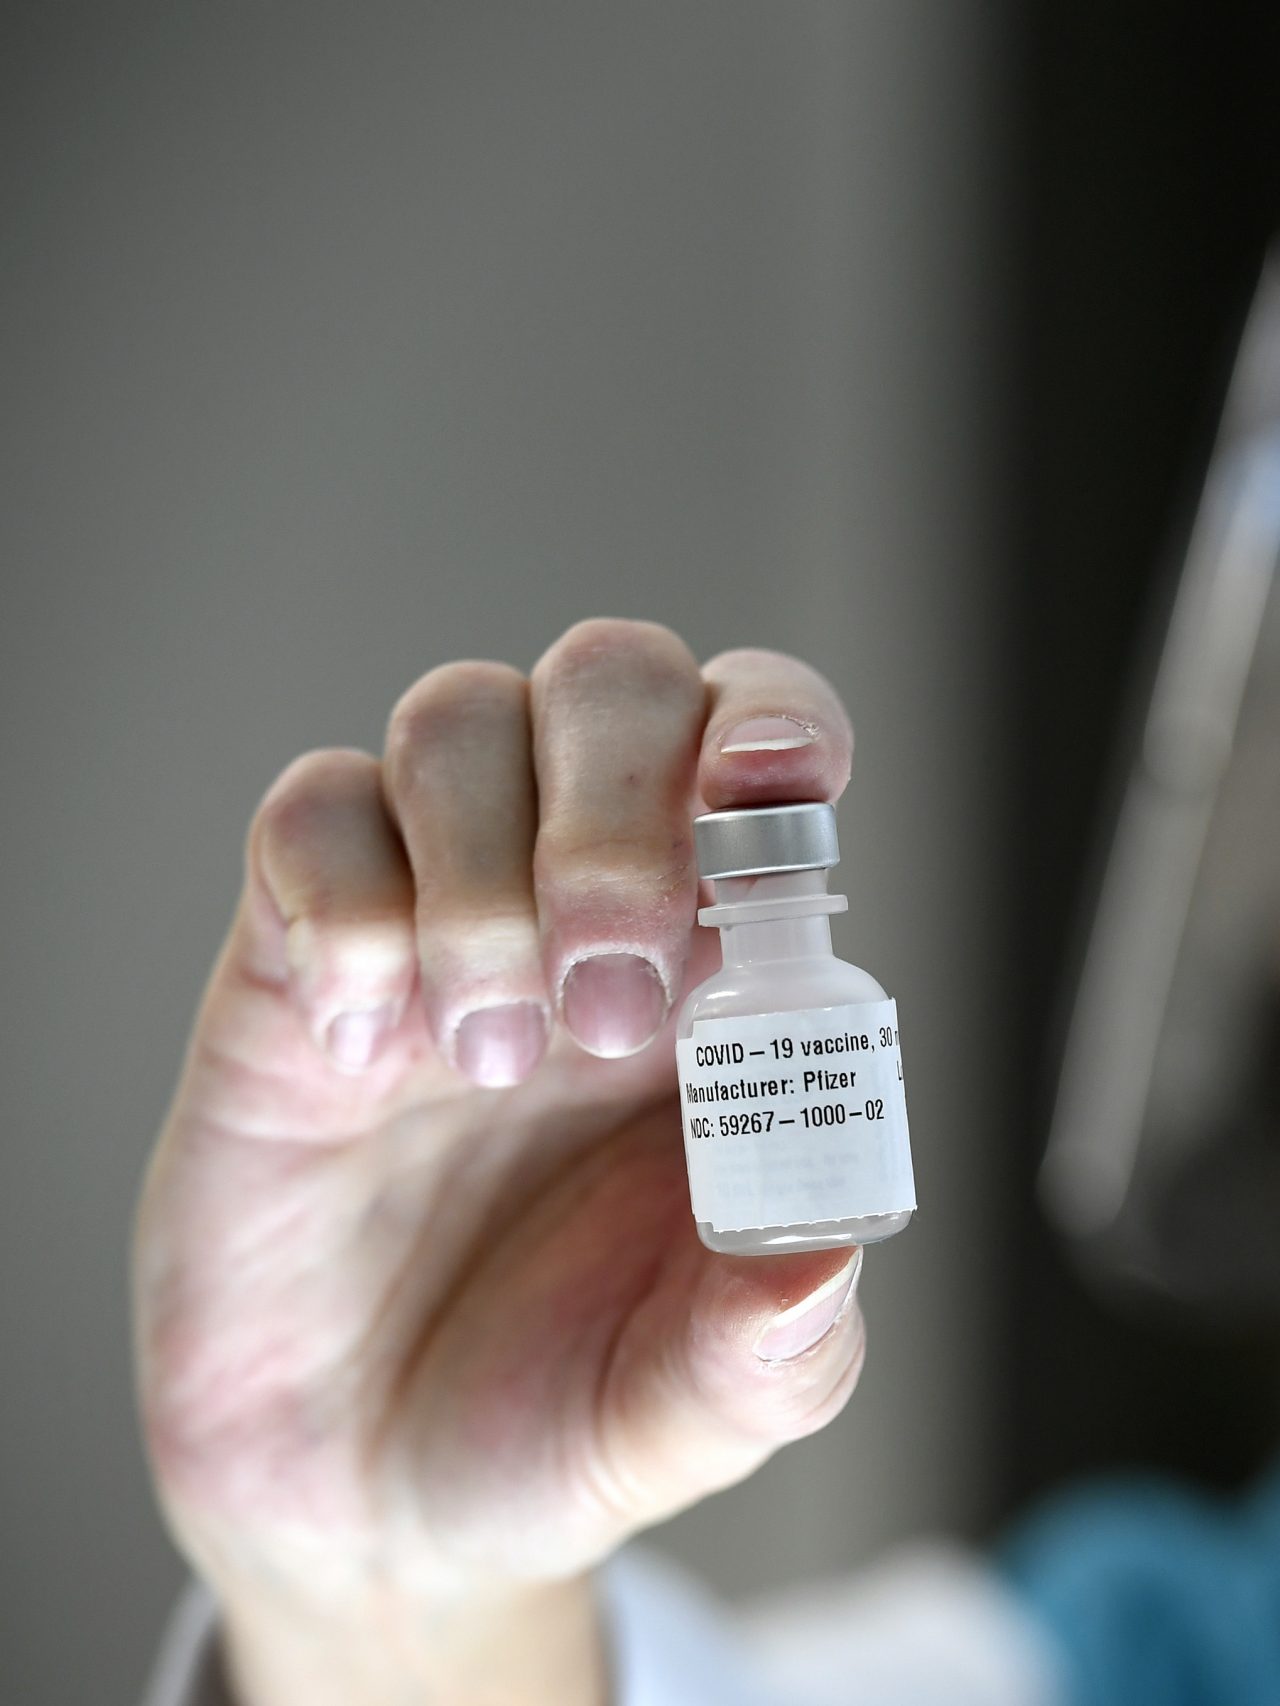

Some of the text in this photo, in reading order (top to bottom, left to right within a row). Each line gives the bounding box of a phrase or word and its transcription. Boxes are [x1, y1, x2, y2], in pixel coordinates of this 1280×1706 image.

[800, 1032, 875, 1056] vaccine,
[879, 1026, 893, 1047] 30
[685, 1070, 857, 1104] Manufacturer: Pfizer
[690, 1117, 715, 1139] NDC:
